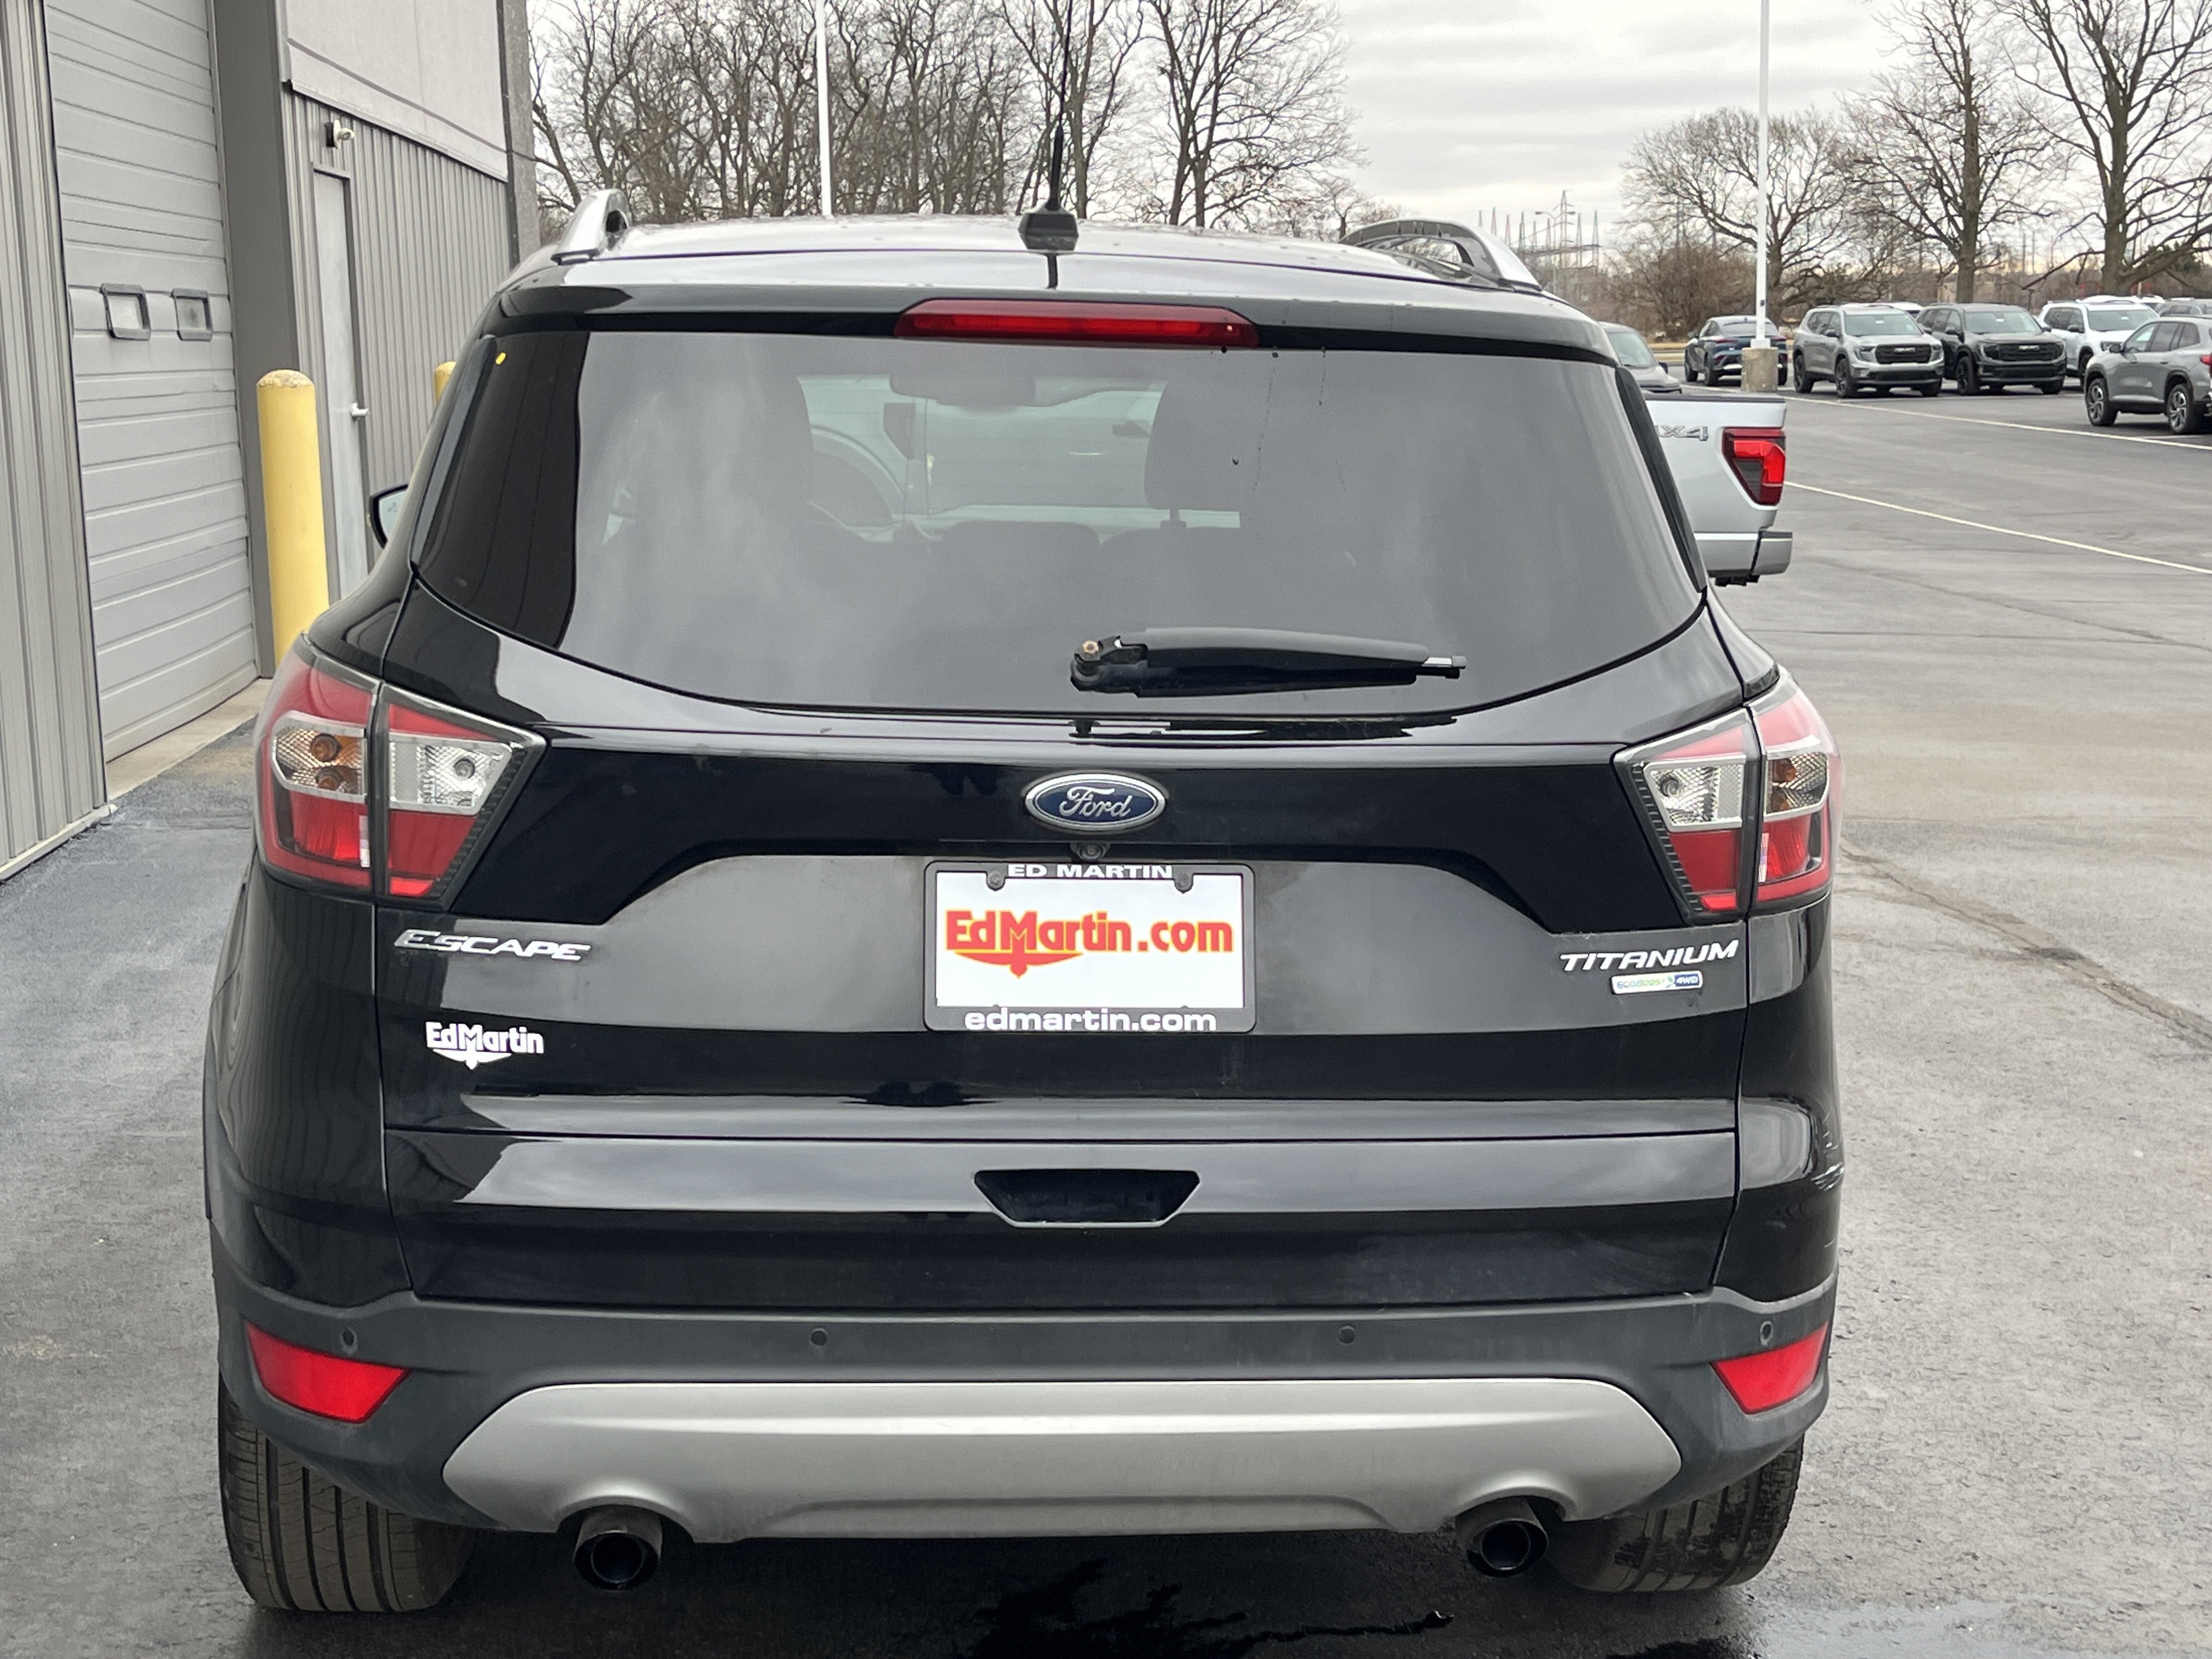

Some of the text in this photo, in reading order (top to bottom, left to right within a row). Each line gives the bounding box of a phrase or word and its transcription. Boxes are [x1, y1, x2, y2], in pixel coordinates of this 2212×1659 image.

[1058, 786, 1132, 817] Ford
[1007, 864, 1172, 878] ED MARTIN
[394, 929, 591, 961] ESCAPE
[1560, 939, 1740, 972] TITANIUM
[964, 1007, 1217, 1031] edmartin.com
[426, 1022, 544, 1054] EdMartin
